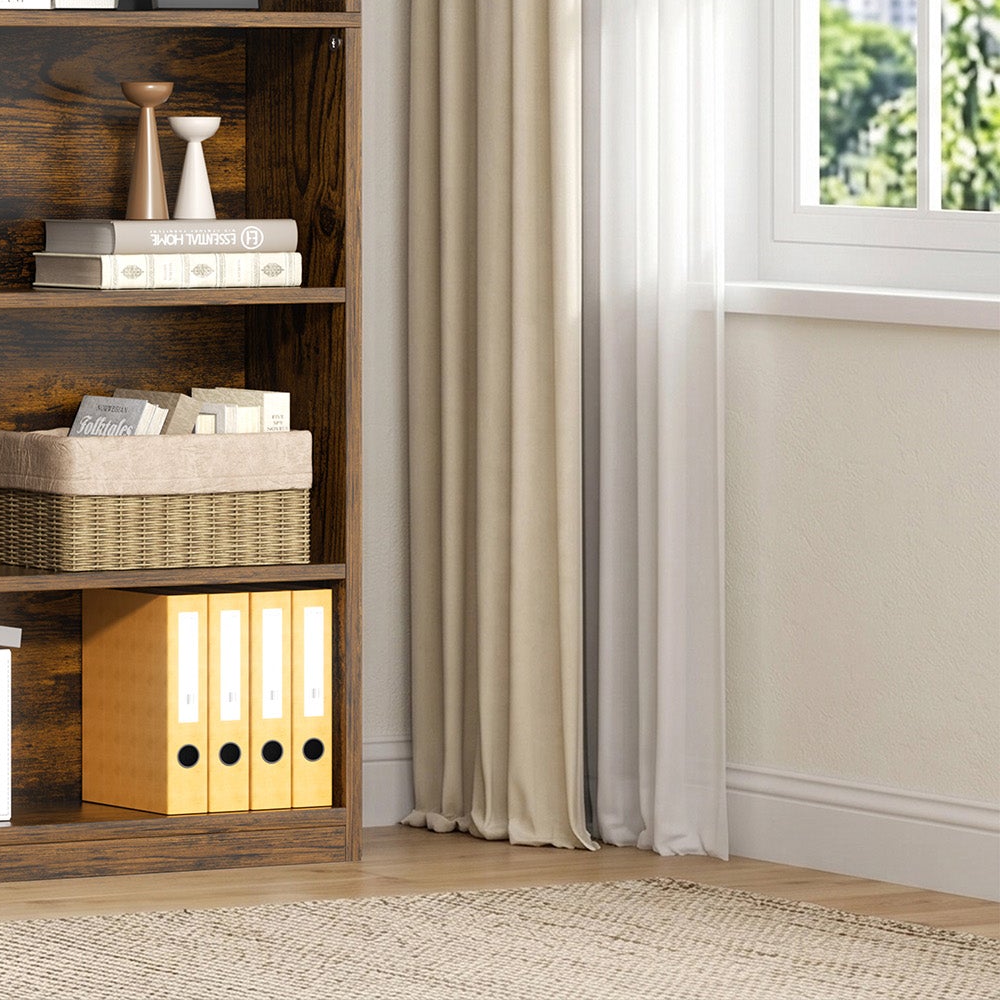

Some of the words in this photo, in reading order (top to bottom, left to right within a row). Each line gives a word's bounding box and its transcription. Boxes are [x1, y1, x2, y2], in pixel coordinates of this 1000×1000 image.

[151, 233, 184, 245] HOME
[185, 233, 236, 245] ESSENTIAL
[77, 415, 133, 436] Folktales
